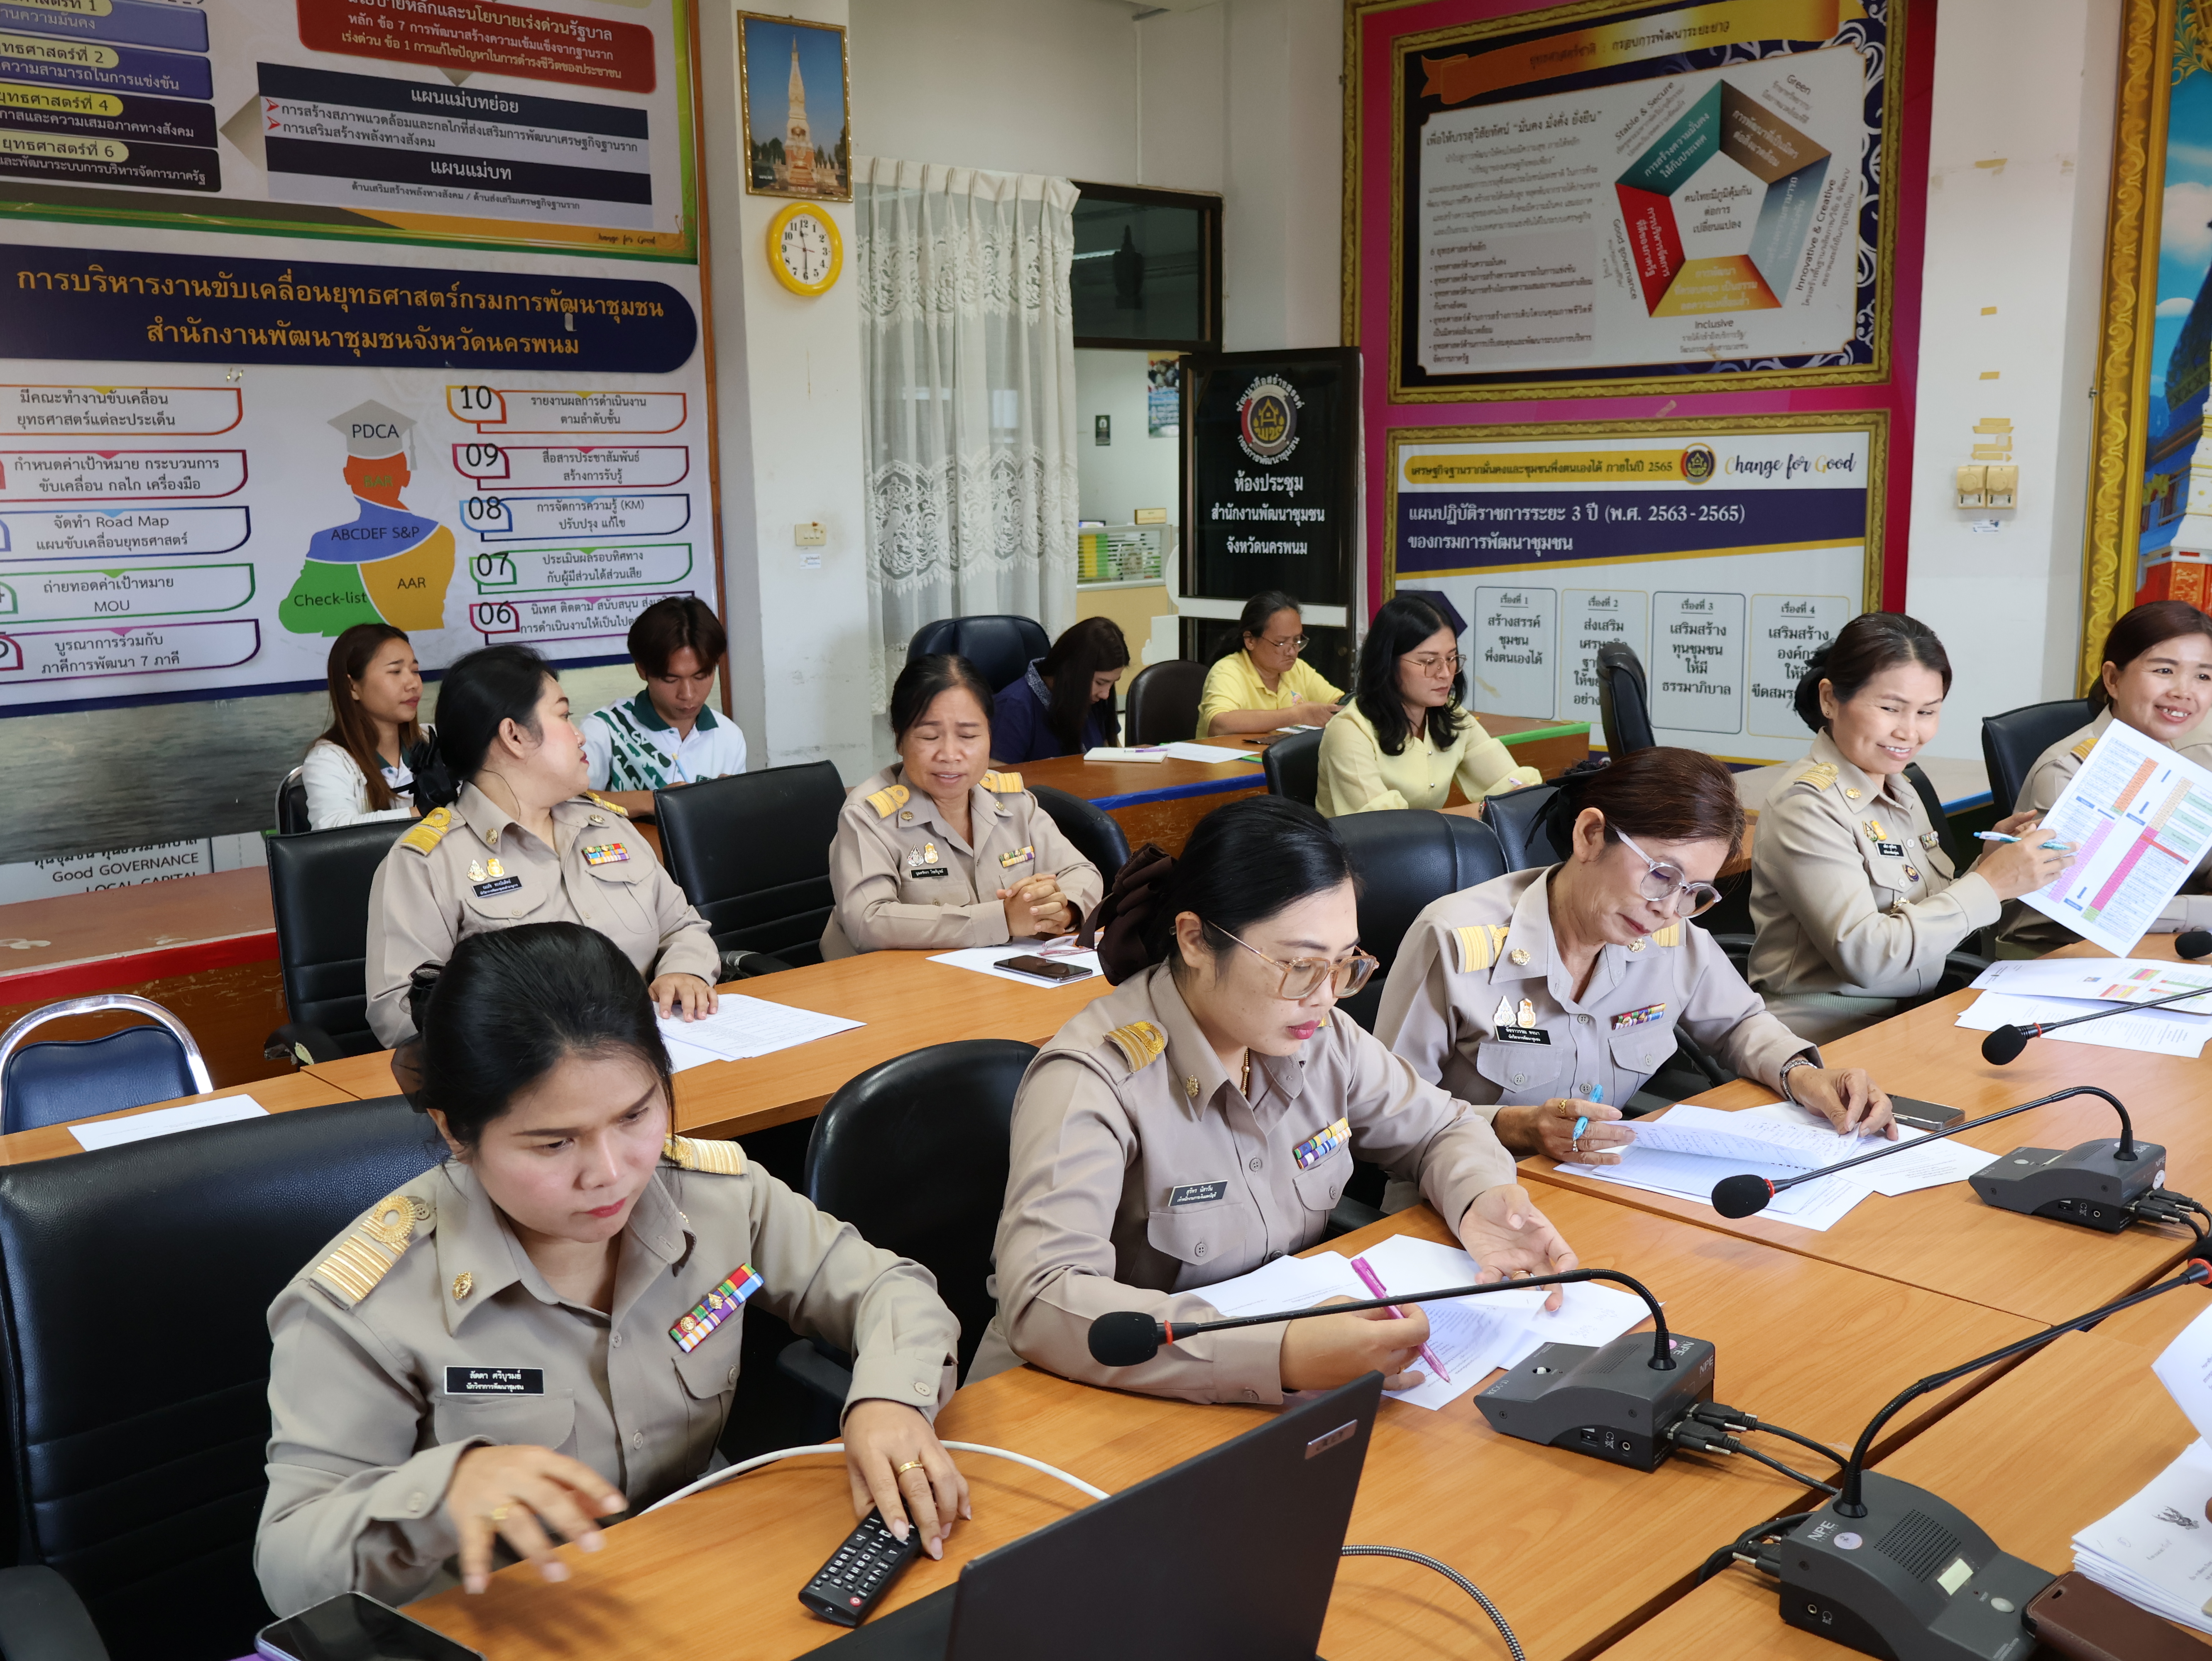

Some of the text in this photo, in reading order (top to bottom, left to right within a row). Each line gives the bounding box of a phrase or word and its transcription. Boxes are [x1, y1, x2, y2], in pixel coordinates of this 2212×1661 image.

[347, 0, 612, 42] ยบายหลักและนโยบายเร่งด่วนรัฐบาล
[349, 13, 373, 27] หลัก
[377, 15, 394, 29] ข้อ
[399, 21, 405, 30] 7
[342, 32, 381, 47] เร่งด่วน
[385, 36, 400, 49] ข้อ
[405, 42, 410, 50] 1
[0, 42, 103, 63] ทธศาสตร์ที่ 2
[0, 61, 179, 91] ความสามารถในการแข่งขัน
[1787, 74, 1811, 95] Green
[99, 99, 108, 111] 4
[411, 88, 519, 113] แผนแม่บทย่อย
[284, 122, 435, 147] การเสริมสร้างพลังทางสังคม
[1615, 118, 1639, 140] Stable
[3, 139, 114, 158] ยุทธศาสตร์ที่ 6
[431, 159, 511, 181] แผนแม่บท
[790, 223, 798, 231] 11
[799, 220, 808, 228] 12
[785, 232, 793, 240] 10
[1796, 179, 1836, 291] Innovative Creative
[1613, 218, 1625, 245] Good
[1619, 242, 1637, 299] governance
[17, 263, 663, 323] การบริหารงานขับเคลื่อนยุทธศาสตร์กรมการพัฒนาชุมชน
[1695, 318, 1734, 328] Inclusive
[147, 316, 579, 357] สำนักงานพัฒนาชุมชนจังหวัดนครพนม
[20, 388, 168, 405] มีคณะทำงานขับเคลื่อน
[460, 385, 492, 409] 10
[531, 394, 646, 407] รายงานผลการดำเนินงาน
[17, 410, 175, 429] ยุทธศาสตร์แต่ละประเด็น
[561, 409, 620, 424] ตามลำดับชั้น
[352, 424, 399, 438] PDCA
[15, 456, 219, 471] กำหนดค่าเป้าหมาย กระบวนการ
[466, 443, 498, 467] 09
[543, 449, 639, 464] สื่อสารประชาสัมพันธ์
[1648, 462, 1673, 472] 2565
[1725, 452, 1856, 480] Change for Good
[40, 473, 201, 492] ขับเคลื่อน กลไก เครื่องมือ
[364, 475, 393, 488] BAR
[564, 468, 622, 484] สร้างการรับรู้
[1234, 470, 1303, 497] ห้องประชุม
[469, 497, 502, 520] 08
[537, 498, 644, 514] การจัดการความรู้ (KM)
[1409, 502, 1641, 524] แผนปฏิบัติราชการระยะ 3 ปี (พ.ศ.
[54, 515, 169, 531] จัดทำ Road Map
[1211, 503, 1325, 527] สำนักงานพัฒนาชุมชน
[560, 516, 626, 532] ปรับปรุง แก้ไข
[37, 532, 188, 552] แผนขับเคลื่อนยุทธศาสตร์
[331, 527, 419, 541] ABCDEF S&P
[1226, 537, 1307, 555] จังหวัดนครพนม
[1408, 531, 1573, 557] ของกรมการพัฒนาชุมชน
[477, 553, 509, 576] 07
[543, 551, 643, 565] ประเมินผลรอบทิศทาง
[397, 577, 426, 589] AAR
[547, 566, 641, 586] กับผู้มีส่วนได้ส่วนเสีย
[44, 576, 174, 594] ถ่ายทอดค่าเป้าหมาย
[95, 600, 130, 612] MOU
[294, 592, 367, 606] Check-list
[531, 598, 639, 615] นิเทศ ติดตาม สนับสนุน
[1500, 594, 1522, 605] เรื่องที่
[1588, 596, 1610, 608] เรื่องที่
[1681, 598, 1705, 610] เรื่องที่
[1781, 601, 1815, 614] เรื่องที่ 4
[479, 601, 511, 625] 06
[1488, 613, 1540, 627] สร้างสรรค์
[520, 615, 637, 634] การดำเนินงานให้เป็นไปต
[1584, 617, 1624, 632] ส่งเสริม
[1670, 622, 1726, 637] เสริมสร้าง
[1499, 635, 1529, 649] ชุมชน
[1769, 626, 1829, 641] เสริมสร้าง
[54, 632, 163, 656] บูรณาการร่วมกับ
[1673, 642, 1723, 659] ทุนชุมชน
[42, 651, 179, 674] ภาคีการพัฒนา 7 ภาคี
[1485, 649, 1542, 664] พึ่งตนเองได้
[1686, 658, 1708, 675] ให้มี
[1662, 681, 1731, 696] ธรรมาภิบาล
[52, 866, 93, 882] Good
[100, 853, 198, 876] GOVERNANCE
[1677, 1341, 1695, 1357] NPE
[470, 1370, 488, 1379] ลัดดา
[466, 1382, 524, 1392] นักวิชาการพัฒนาชุมชน
[1807, 1520, 1835, 1542] NPE
